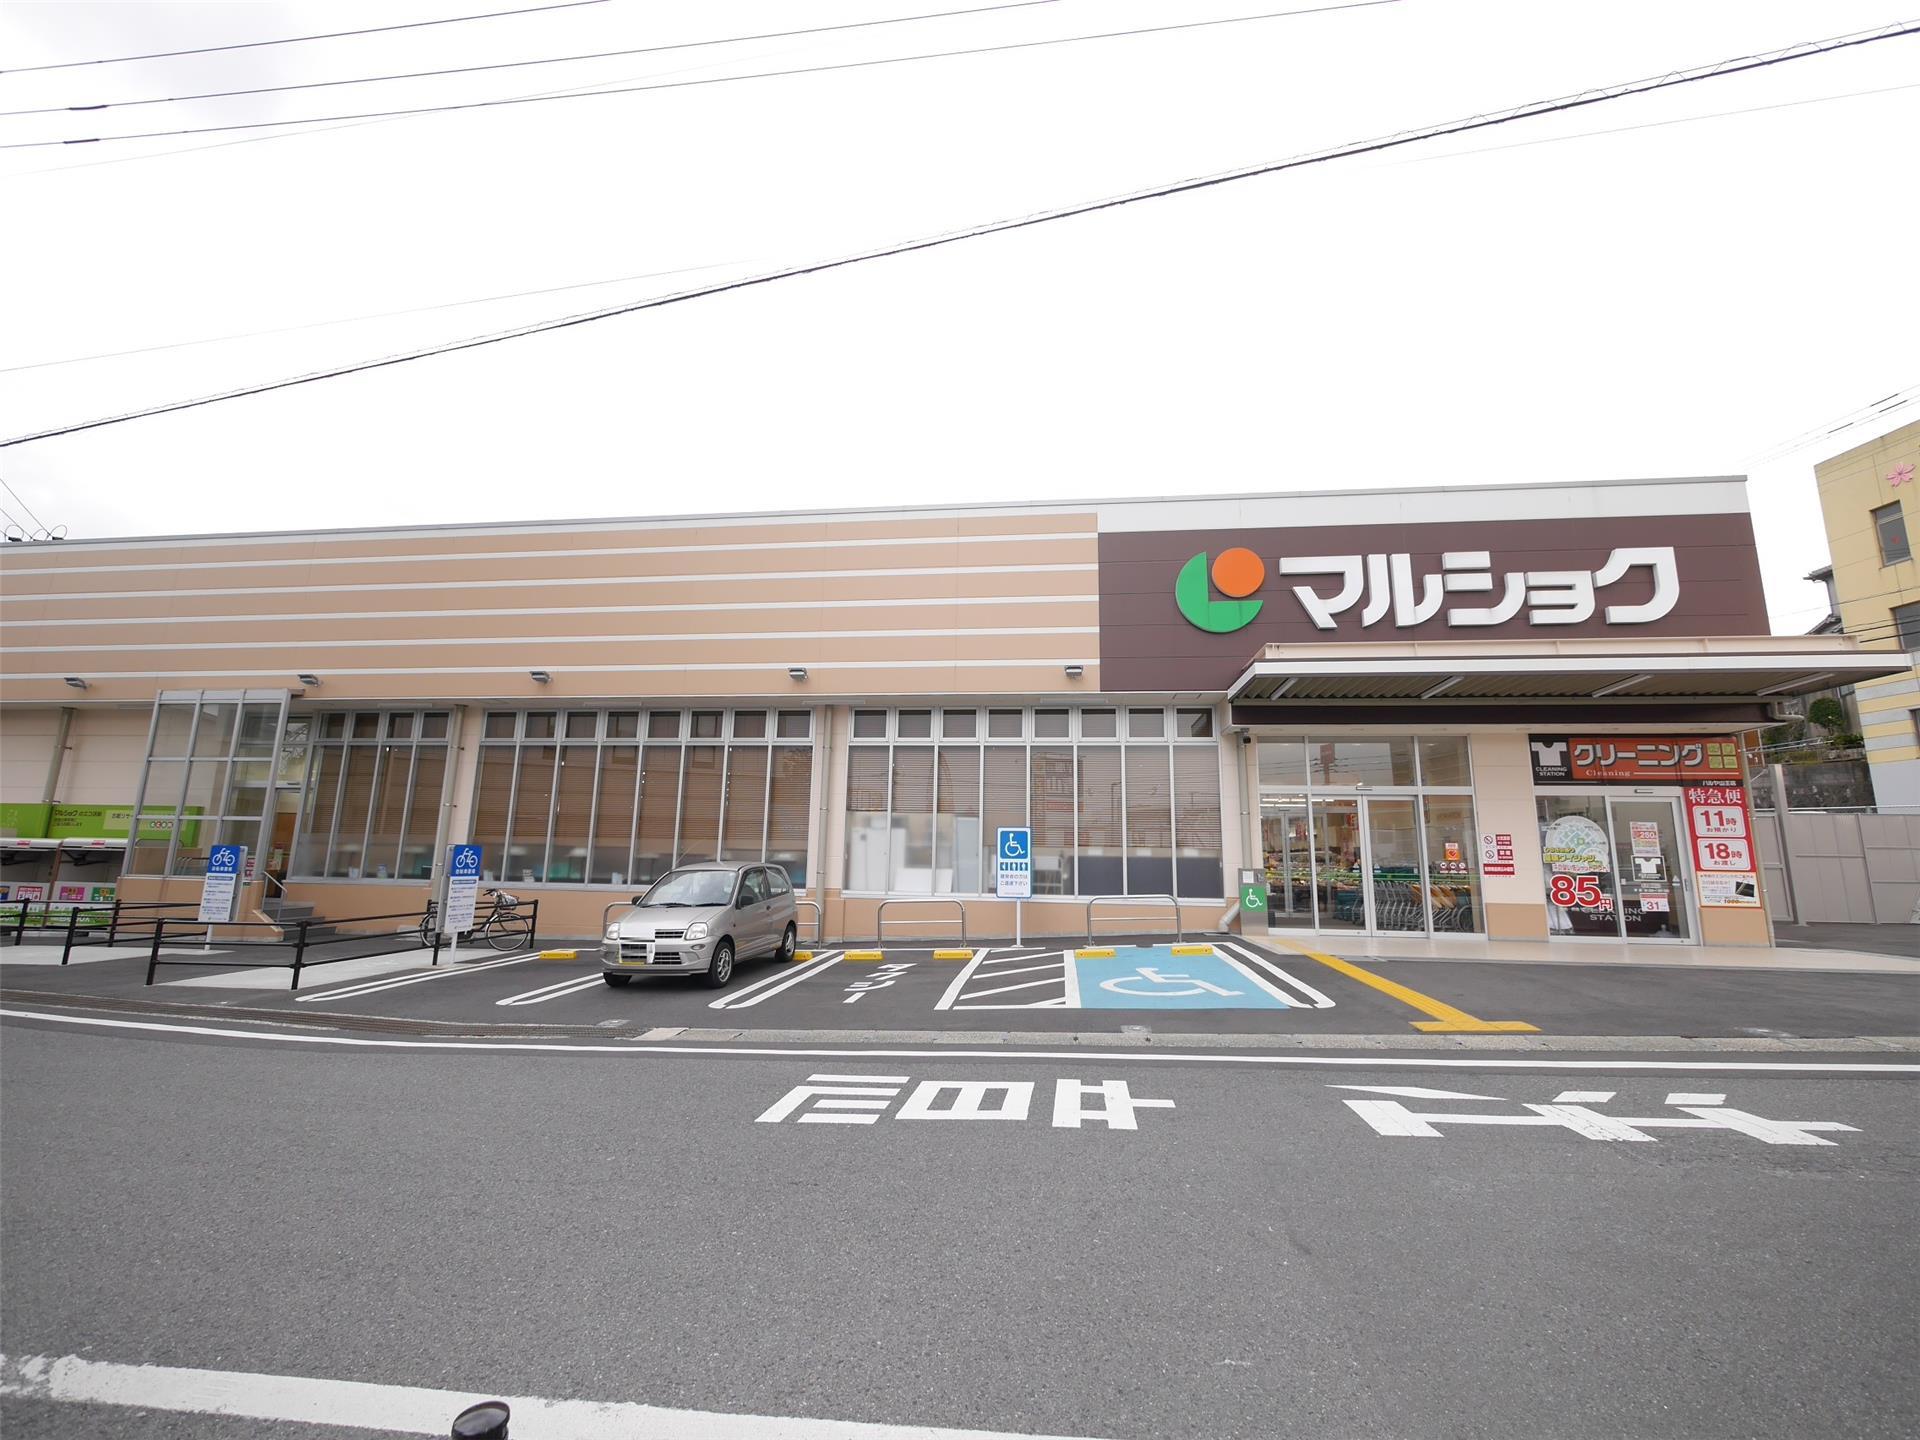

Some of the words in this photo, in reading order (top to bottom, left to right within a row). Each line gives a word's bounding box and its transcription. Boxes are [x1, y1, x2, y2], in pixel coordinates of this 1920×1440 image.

[1279, 546, 1680, 629] マルショク
[1574, 743, 1703, 767] クリーニング
[1586, 769, 1631, 777] Cleaning
[1689, 788, 1742, 804] 特急便
[1700, 810, 1737, 827] 11時
[1704, 843, 1742, 859] 18時
[1550, 874, 1613, 911] 85円
